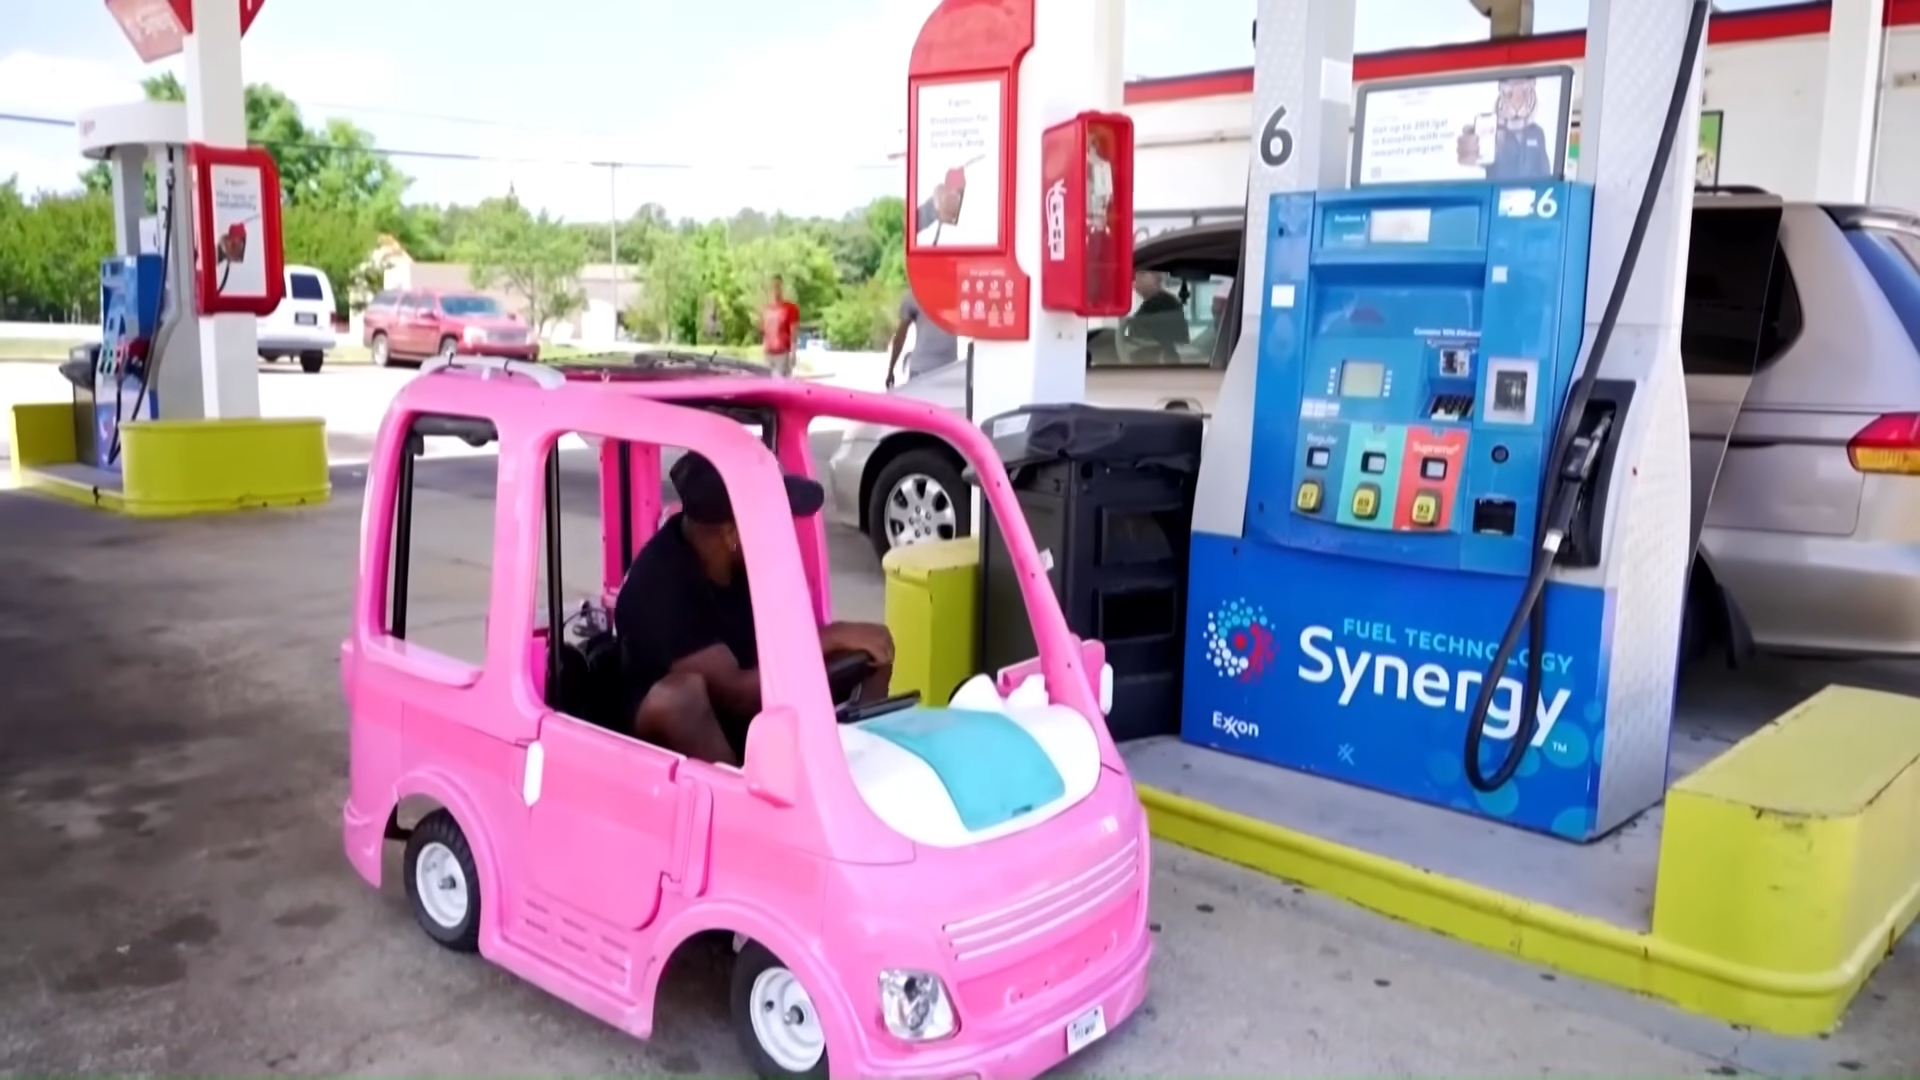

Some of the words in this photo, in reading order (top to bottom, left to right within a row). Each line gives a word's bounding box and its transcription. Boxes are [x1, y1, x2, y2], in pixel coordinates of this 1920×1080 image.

[1260, 105, 1293, 166] 6
[1536, 187, 1557, 218] 6
[1052, 201, 1062, 253] FIRE
[1357, 496, 1370, 507] 89
[1417, 503, 1430, 515] 93
[1343, 617, 1397, 644] FUEL
[1298, 625, 1571, 747] Synergy
[1212, 710, 1259, 739] Exxon
